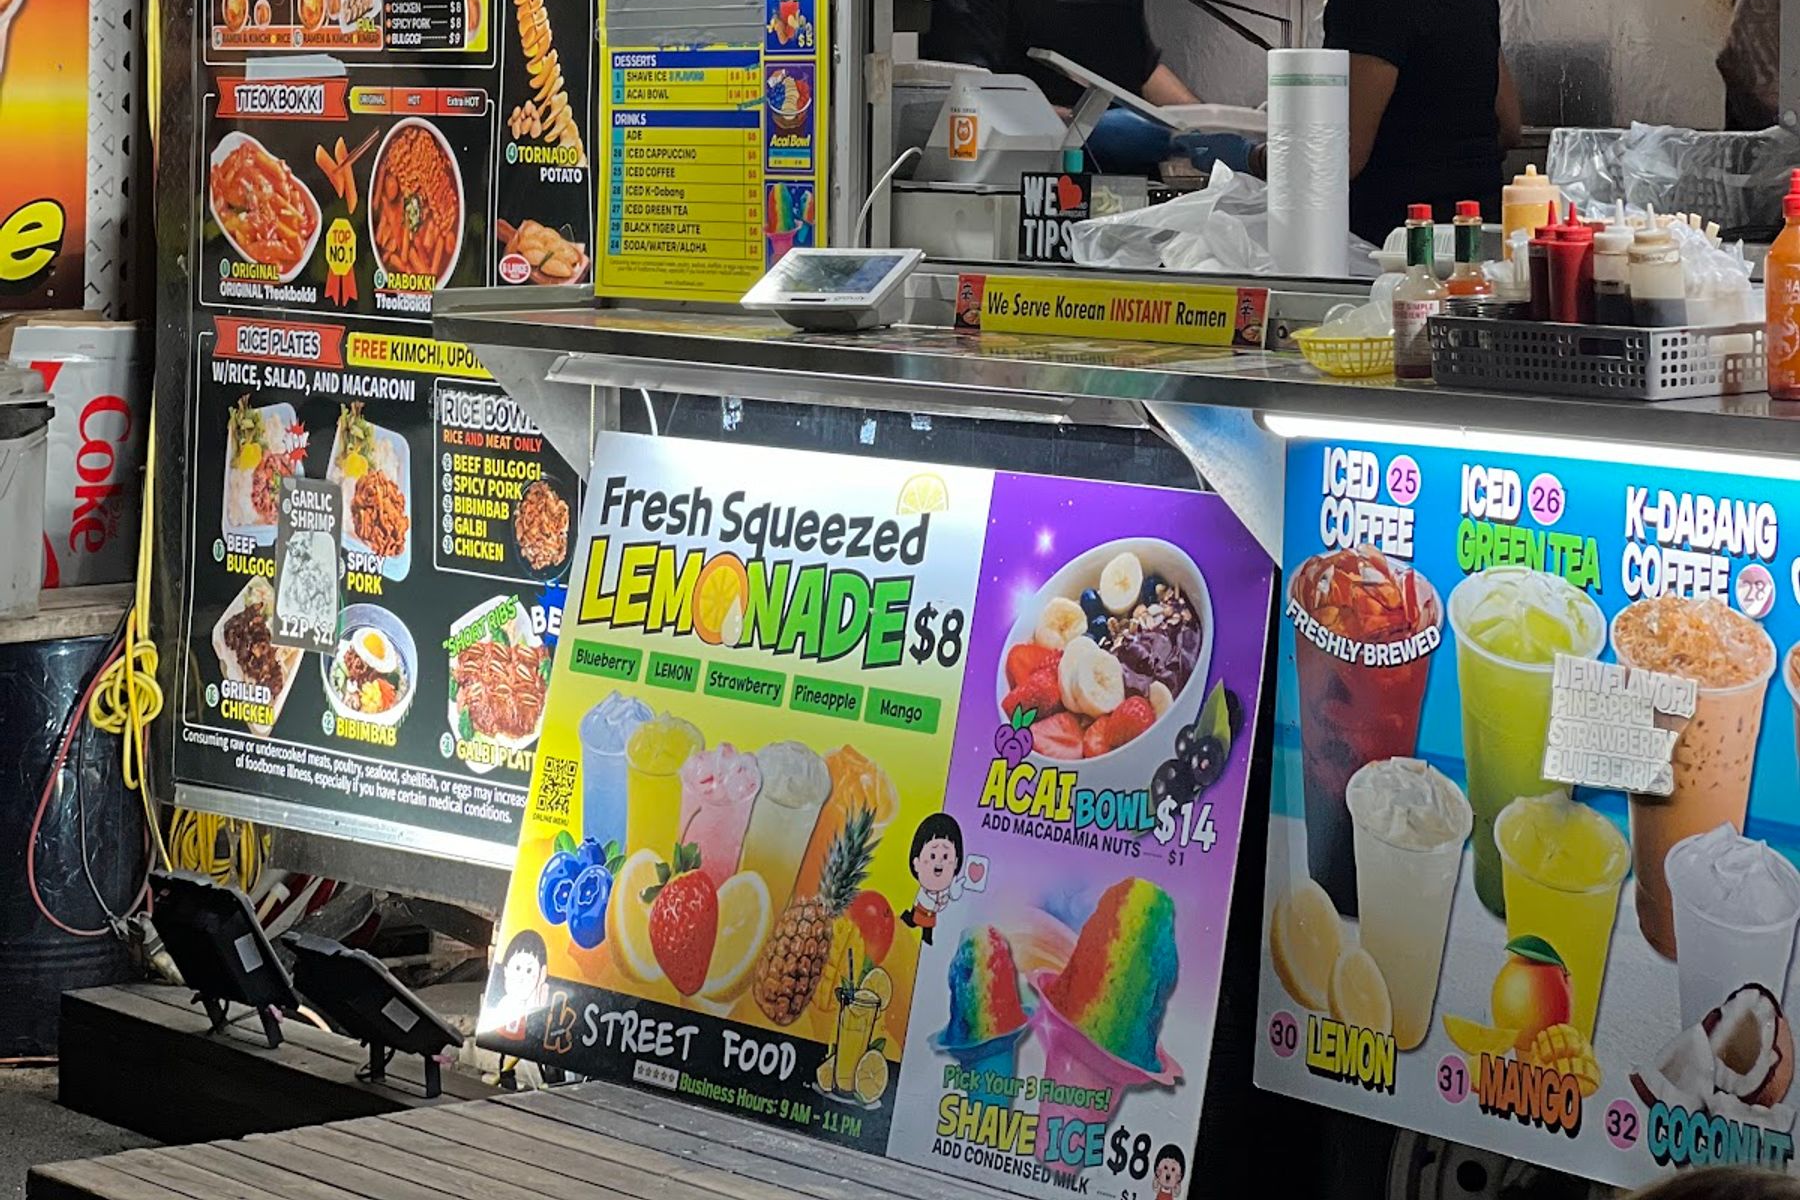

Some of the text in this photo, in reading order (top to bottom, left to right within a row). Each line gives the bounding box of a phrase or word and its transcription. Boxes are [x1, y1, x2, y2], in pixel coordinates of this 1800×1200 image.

[392, 2, 421, 13] CHICKEN
[392, 33, 422, 45] BULGOGI
[614, 55, 657, 67] DESSERTS
[236, 85, 324, 113] TTEOKBOKKI
[614, 113, 646, 125] DRINKS
[518, 146, 578, 164] TORNADO
[626, 148, 697, 160] ICED CAPPUCCINO
[540, 168, 582, 183] POTATO
[1024, 175, 1059, 217] WE
[332, 230, 351, 243] TOP
[624, 221, 701, 234] BLACK TIGER LATTE
[1023, 219, 1074, 260] TIPS
[330, 246, 353, 263] NO.1
[232, 263, 280, 280] ORIGINAL
[387, 273, 436, 291] RABOKKI
[220, 283, 263, 298] ORIGINAL
[987, 290, 1227, 329] We Serve Korean INSTANT Ramen
[239, 329, 319, 358] RICE PLATES
[353, 339, 444, 367] FREE KIMCHI,
[212, 360, 415, 402] W/RICE, SALAD, AND MACARONI
[441, 395, 481, 425] RICE
[443, 430, 542, 453] RICE AND MEAT ONLY
[68, 394, 133, 554] Coke
[453, 453, 541, 480] BEEF BULGOGI
[1320, 446, 1419, 502] ICED 25
[290, 489, 333, 512] GARLIC
[453, 474, 523, 500] SPICY PORK
[1460, 463, 1562, 524] ICED 26
[289, 509, 336, 533] SHRIMP
[454, 495, 509, 520] BIBIMBAB
[600, 475, 931, 566] Fresh Squeezed
[454, 516, 487, 538] GALBI
[1318, 497, 1415, 561] COFFEE
[1624, 484, 1778, 562] K-DABANG
[226, 534, 257, 554] BEEF
[454, 537, 504, 562] CHICKEN
[1456, 519, 1604, 593] GREEN TEA
[347, 551, 385, 574] SPICY
[1620, 541, 1730, 606] COFFEE
[1740, 579, 1766, 603] 28
[347, 572, 383, 595] PORK
[577, 535, 965, 670] LEMONADE $8
[279, 615, 309, 639] 12P
[1285, 598, 1442, 668] FRESHLY BREWED
[221, 679, 272, 703] GRILLED
[575, 646, 923, 723] Blueberry LEMON Strawberry Pineapple Mango
[1554, 662, 1603, 695] NEW
[220, 699, 274, 726] CHICKEN
[1554, 691, 1653, 725] PINEAPPLE
[336, 717, 398, 747] BIBIMBAB
[1550, 719, 1678, 761] STRAWBERRY
[182, 727, 493, 804] Consuming raw or undercooked meats, poultry, seafood, shellfish, or eggs may
[456, 740, 495, 765] GALBI
[1546, 750, 1673, 794] BLUEBERRIES
[236, 755, 512, 823] of foodborne illness, especially if you have certain medical conditions.
[978, 758, 1218, 853] ACAI BOWL $14
[980, 812, 1141, 859] ADD MACADAMIA NUTS
[582, 1003, 797, 1081] STREET FOOD
[1270, 1014, 1397, 1096] 30 LEMON
[942, 1063, 1114, 1112] Pick Your 3 Flavors!
[1438, 1052, 1583, 1138] 31 MANGO
[679, 1072, 862, 1138] Business Hours: 9 AM 11 PM
[936, 1093, 1152, 1181] SHAVE ICE $8
[1606, 1111, 1639, 1141] 32
[932, 1138, 1090, 1195] ADD CONDENSED MILK
